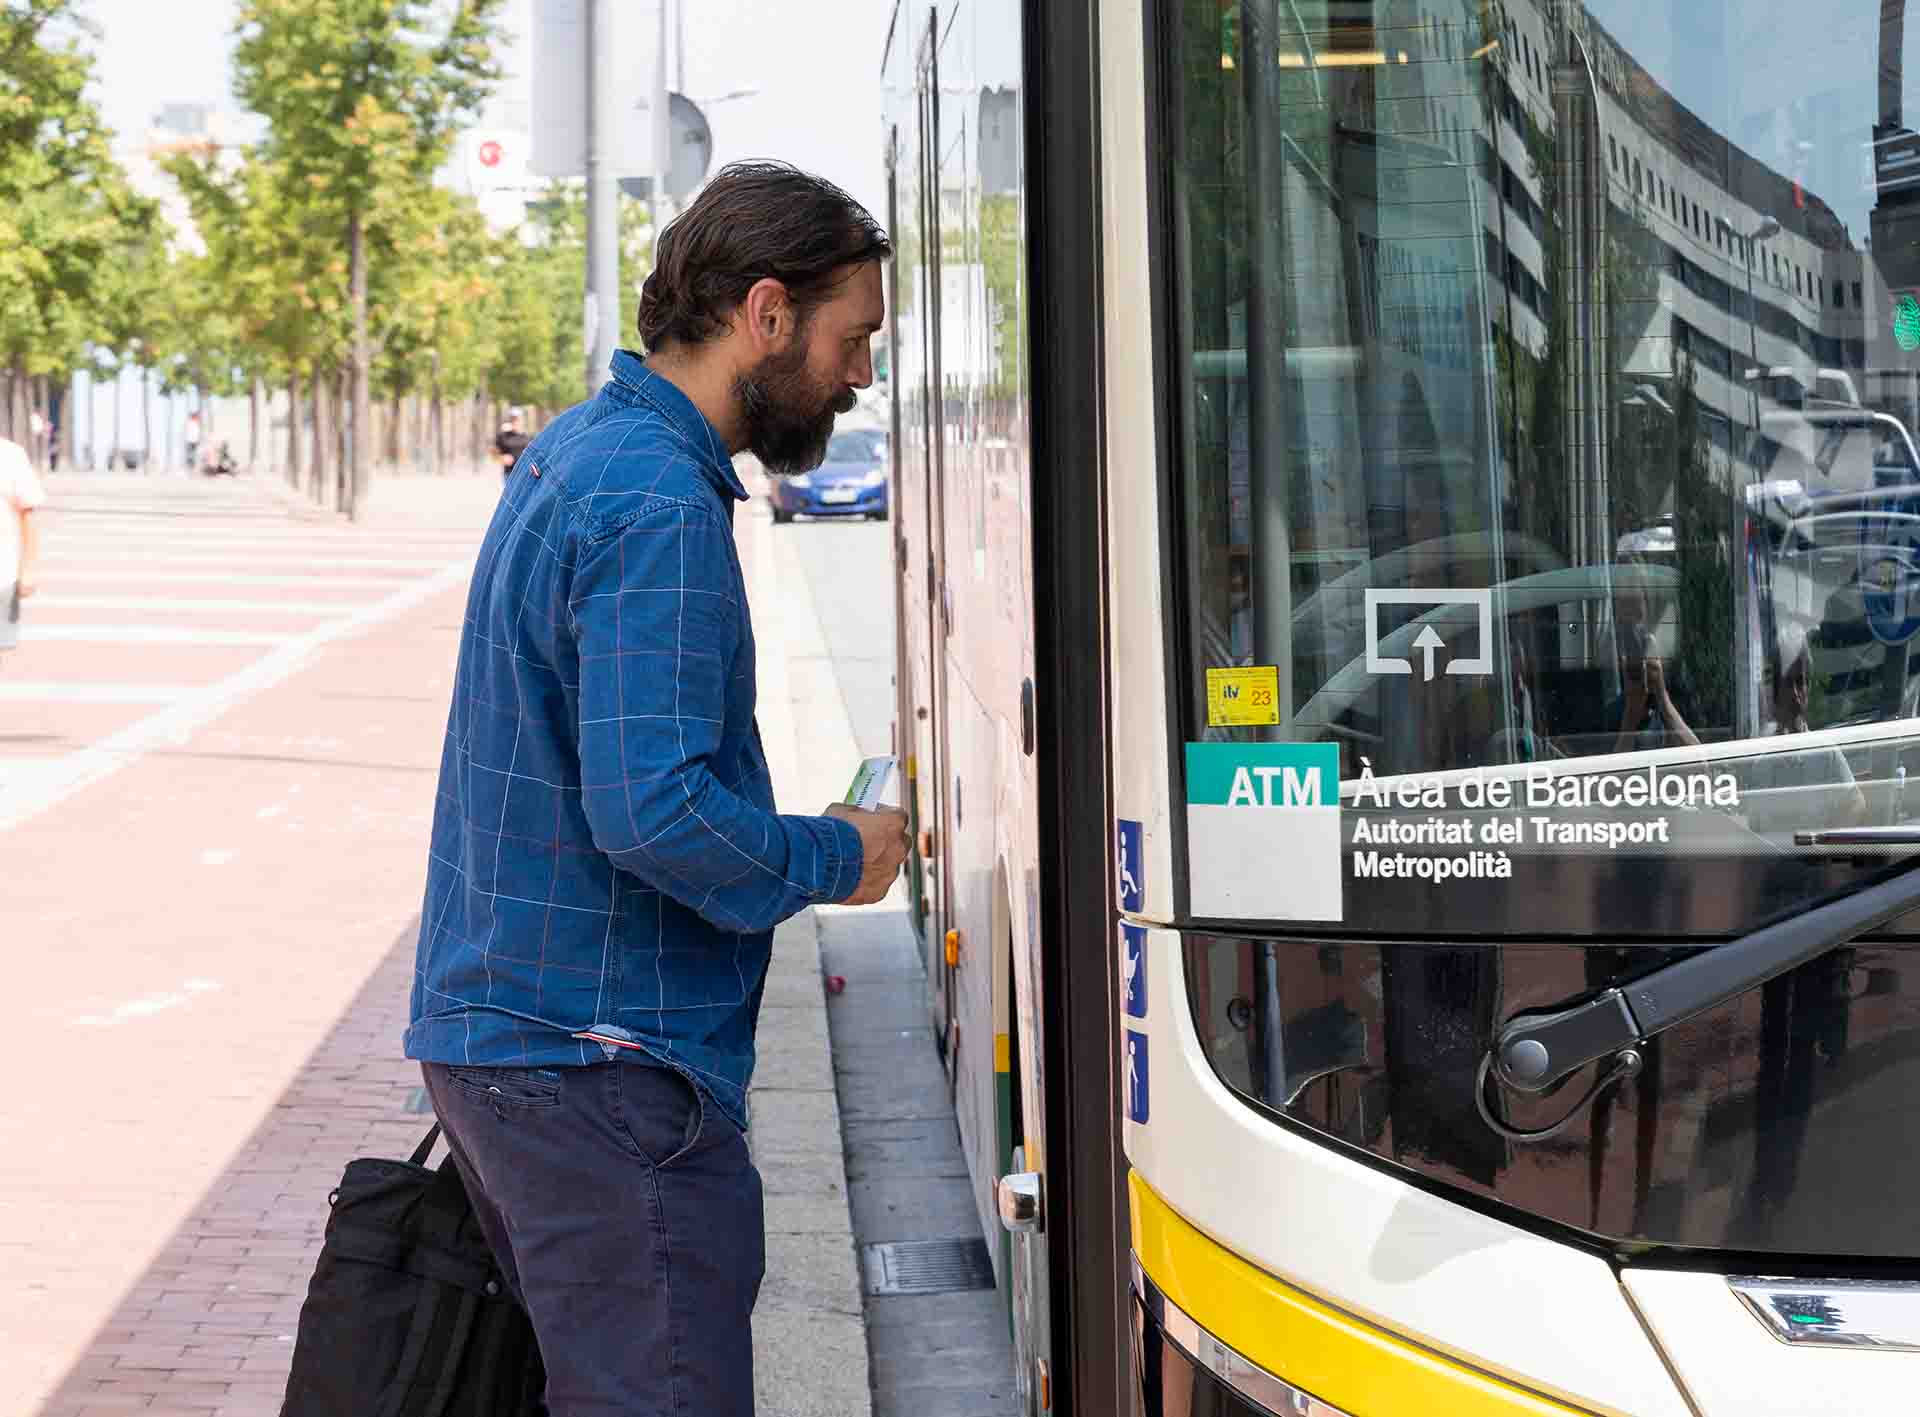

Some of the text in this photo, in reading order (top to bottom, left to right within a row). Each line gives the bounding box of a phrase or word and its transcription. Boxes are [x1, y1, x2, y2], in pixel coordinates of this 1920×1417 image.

[1251, 689, 1271, 706] 23
[1227, 766, 1322, 808] ATM
[1352, 756, 1740, 808] Àrea de Barcelona
[1352, 817, 1670, 849] Autoritat del Transport
[1353, 850, 1513, 884] Metropolità
